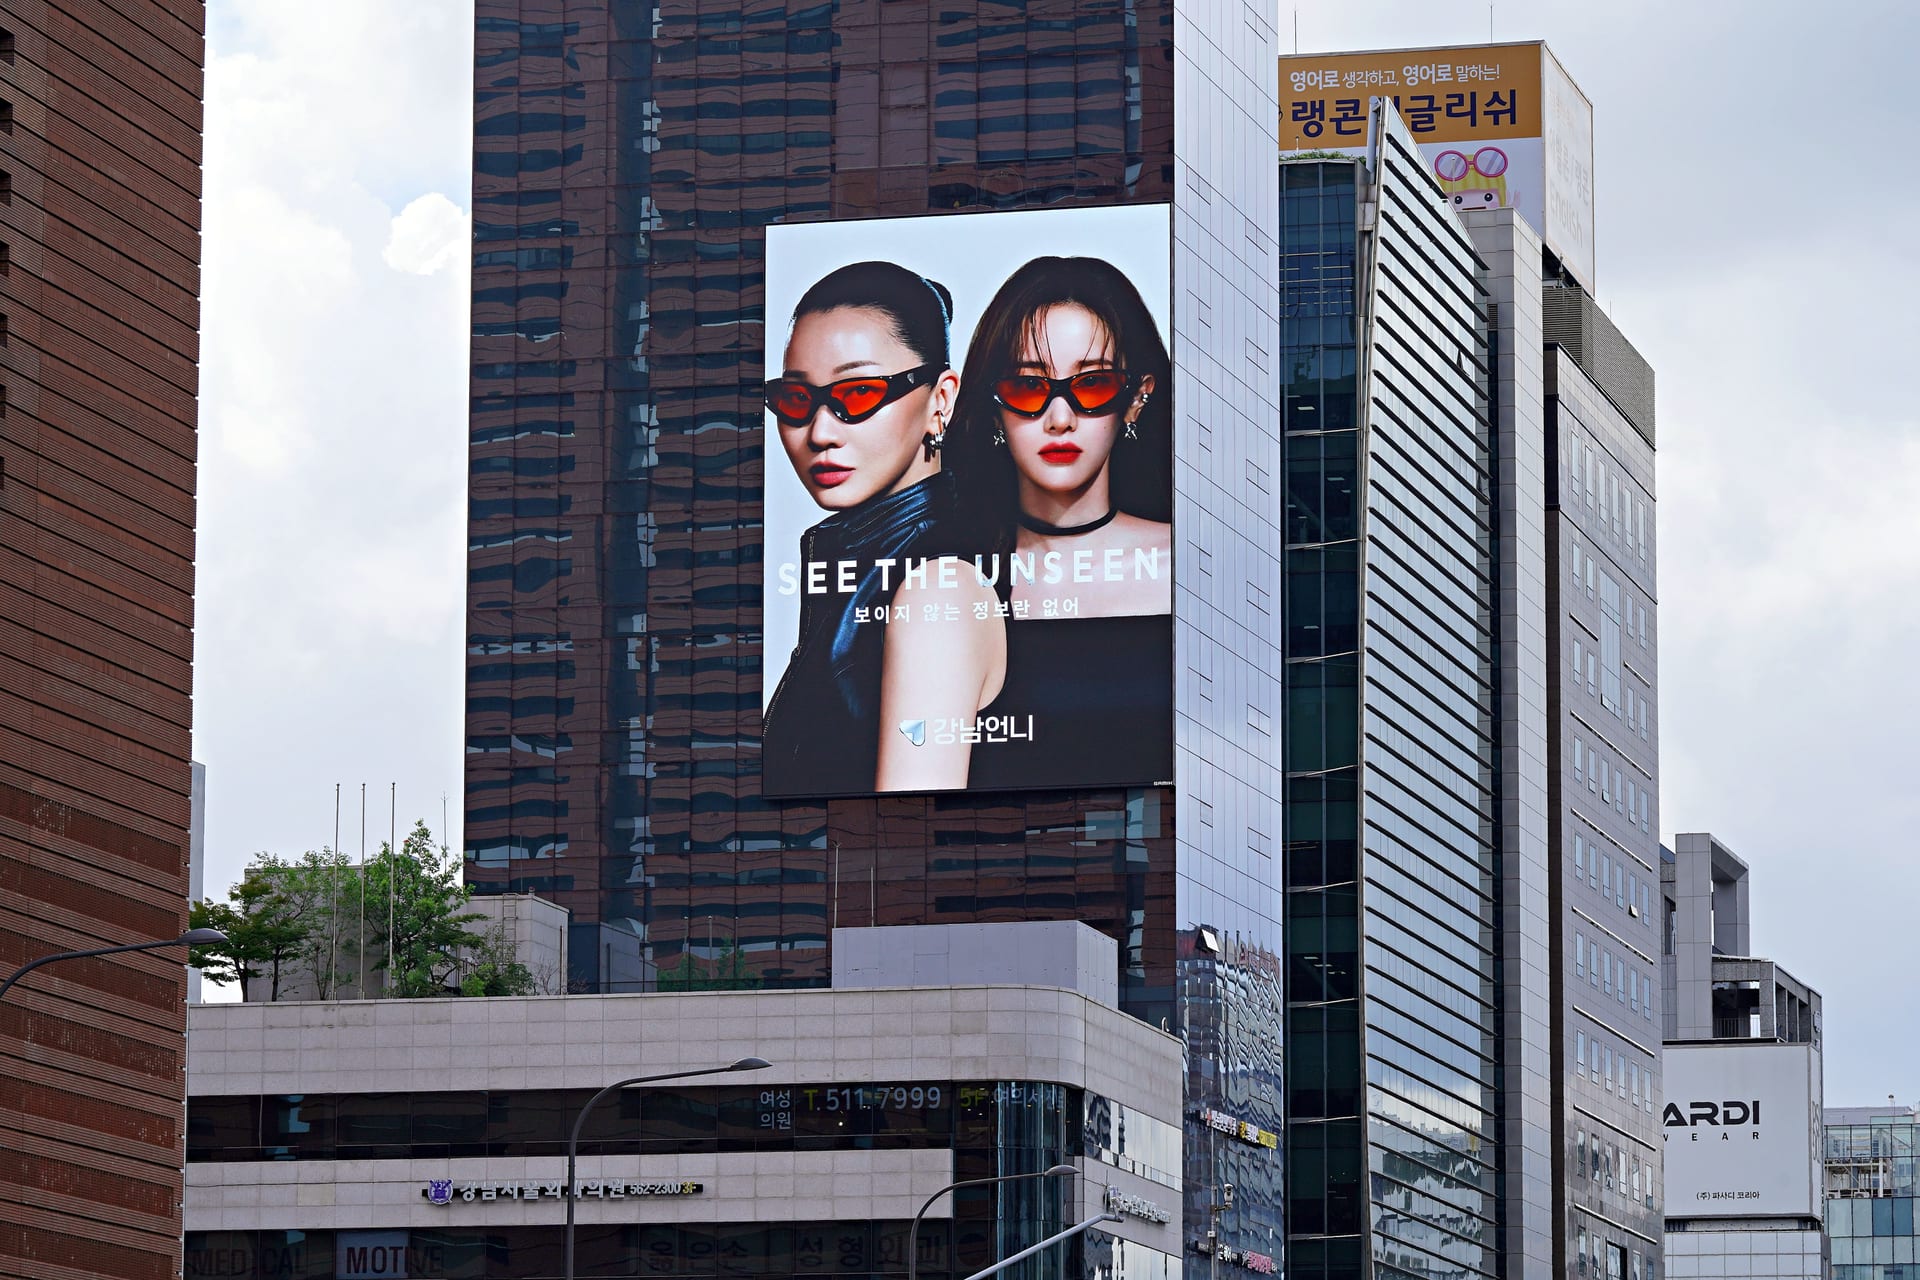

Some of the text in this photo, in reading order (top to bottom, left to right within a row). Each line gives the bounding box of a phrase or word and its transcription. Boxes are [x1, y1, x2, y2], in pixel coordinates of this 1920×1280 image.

[1290, 63, 1501, 93] 영어로 생각하고, 영어로 말하는!
[1291, 89, 1517, 138] 랭콘글리쉬
[778, 547, 1160, 596] SEE THE UNSEEN
[853, 596, 1080, 624] 보이지 않는 정보란 없어
[932, 714, 1034, 745] 강남언니
[759, 1089, 791, 1109] 여성
[960, 1087, 985, 1108] 5F
[759, 1111, 791, 1130] 의원
[629, 1182, 681, 1195] 562-2300
[682, 1181, 696, 1194] 3F
[1736, 1191, 1760, 1199] 코리아
[347, 1246, 441, 1274] MOTIVE
